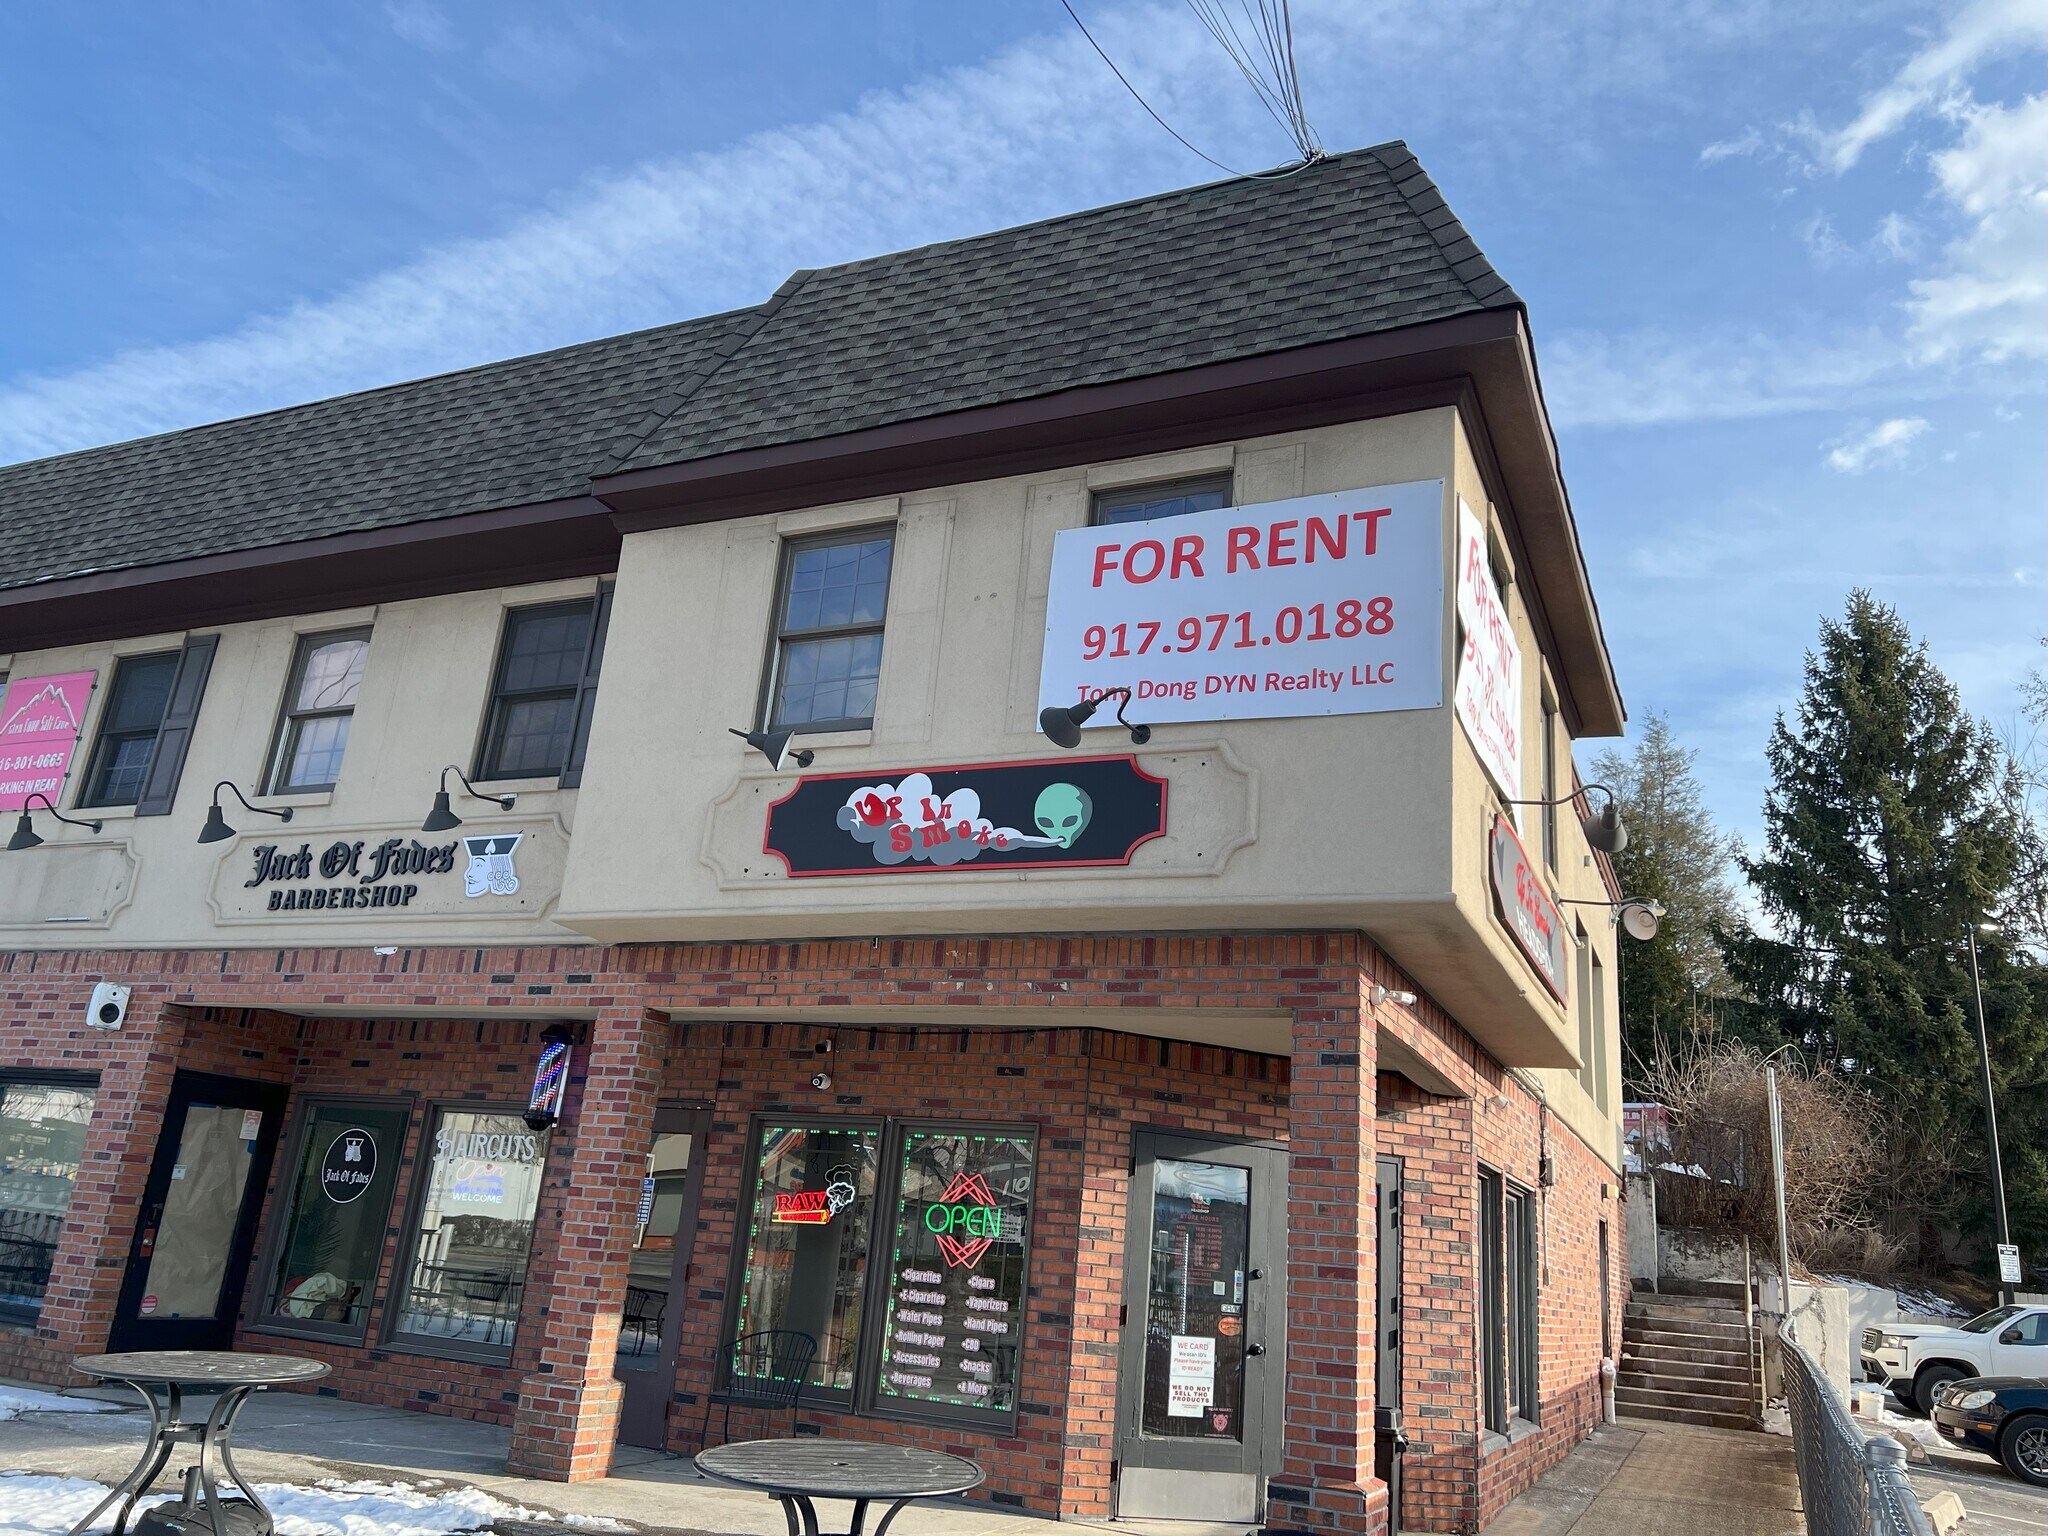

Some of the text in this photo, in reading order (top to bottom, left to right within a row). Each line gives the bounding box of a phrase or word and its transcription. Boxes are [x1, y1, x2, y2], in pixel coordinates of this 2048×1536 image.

[1092, 508, 1392, 588] FOR RENT
[1082, 596, 1394, 660] 917.971.0188
[1137, 679, 1198, 700] Dong
[1204, 674, 1256, 695] DYN
[1264, 668, 1343, 692] Realty
[1352, 663, 1394, 685] LLC
[24, 780, 34, 793] IN
[33, 778, 58, 792] REAR
[244, 838, 458, 888] Jack Of Fades
[267, 885, 417, 911] BARBERSHOP
[433, 1129, 536, 1160] HAIRCUTS
[325, 1169, 340, 1182] Jack
[349, 1171, 370, 1184] Fades
[456, 1160, 507, 1184] Open
[452, 1192, 503, 1204] WELCOME
[775, 1191, 828, 1211] RAW
[926, 1204, 1001, 1237] OPEN
[1200, 1215, 1219, 1223] HOURS
[905, 1268, 942, 1284] Cigarettes
[971, 1275, 996, 1290] Cigars
[902, 1289, 946, 1306] E-Cigarettes
[969, 1296, 1009, 1312] Vaporizers
[900, 1309, 943, 1326] Water Pipes
[967, 1316, 1008, 1334] Hand Pipes
[898, 1330, 946, 1348] Rolling Paper
[965, 1338, 980, 1352] CBD
[896, 1351, 941, 1368] Accessories
[963, 1359, 990, 1373] Snacks
[894, 1372, 932, 1388] Beverages
[967, 1382, 988, 1395] More
